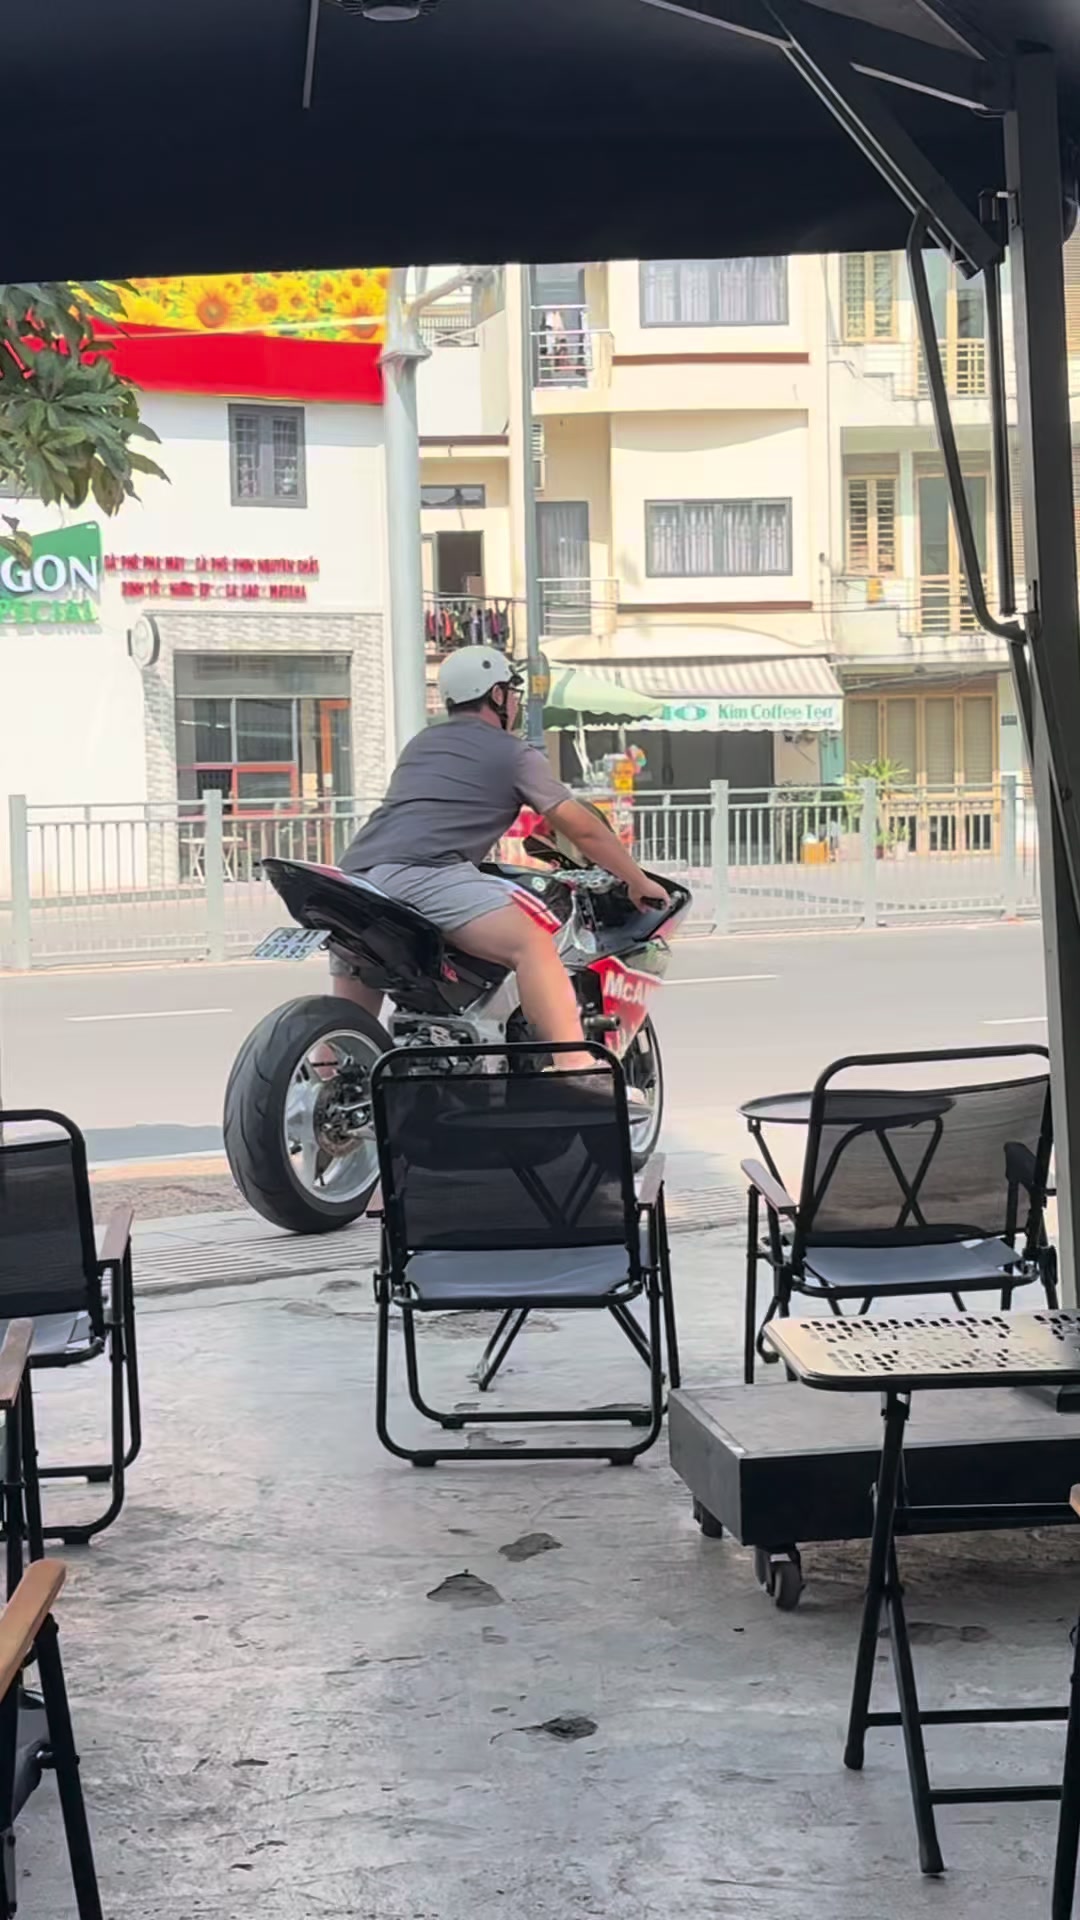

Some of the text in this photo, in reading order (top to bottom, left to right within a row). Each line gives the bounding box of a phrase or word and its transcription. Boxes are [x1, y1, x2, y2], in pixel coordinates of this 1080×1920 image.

[718, 703, 833, 720] Kim Coffee Tea
